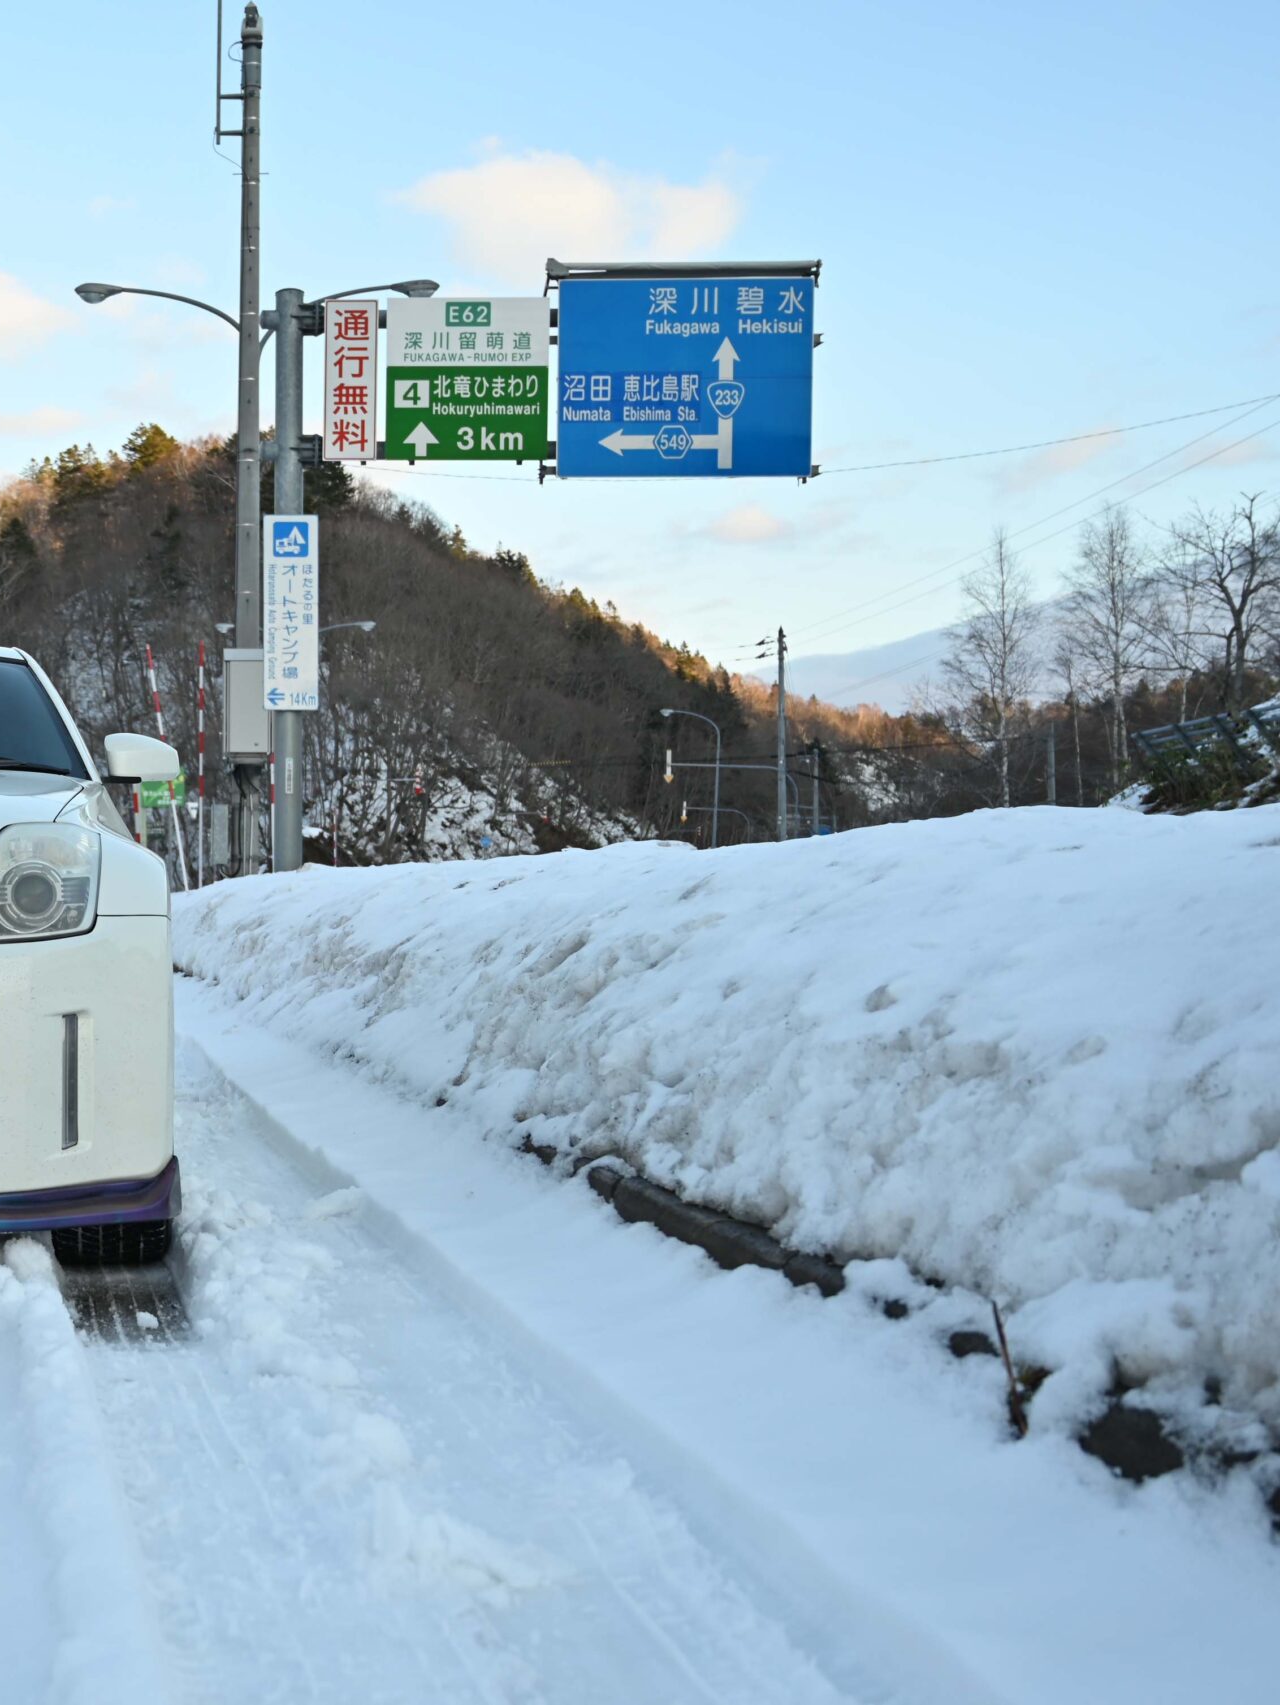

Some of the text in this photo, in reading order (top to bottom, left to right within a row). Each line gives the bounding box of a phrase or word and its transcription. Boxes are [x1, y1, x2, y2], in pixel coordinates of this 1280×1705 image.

[649, 287, 805, 314] 深川 碧水
[449, 306, 488, 323] E62
[646, 319, 803, 337] Fukagawa Hekisui
[404, 332, 532, 350] 深川留萌道
[511, 353, 532, 362] EXP
[332, 309, 370, 452] 通行無料
[433, 375, 539, 398] 北竜ひまわり
[563, 374, 699, 401] 沼田 恵比島駅
[402, 382, 422, 405] 4
[715, 389, 739, 406] 233
[432, 402, 540, 417] Hokuryuhimawari
[563, 406, 698, 421] Numata Ebishima Sta.
[660, 434, 686, 450] 549
[302, 564, 313, 625] ほたるの里
[268, 609, 277, 624] Auto
[282, 564, 298, 679] オートキャンプ場
[267, 627, 277, 654] Camping
[268, 657, 277, 680] Ground
